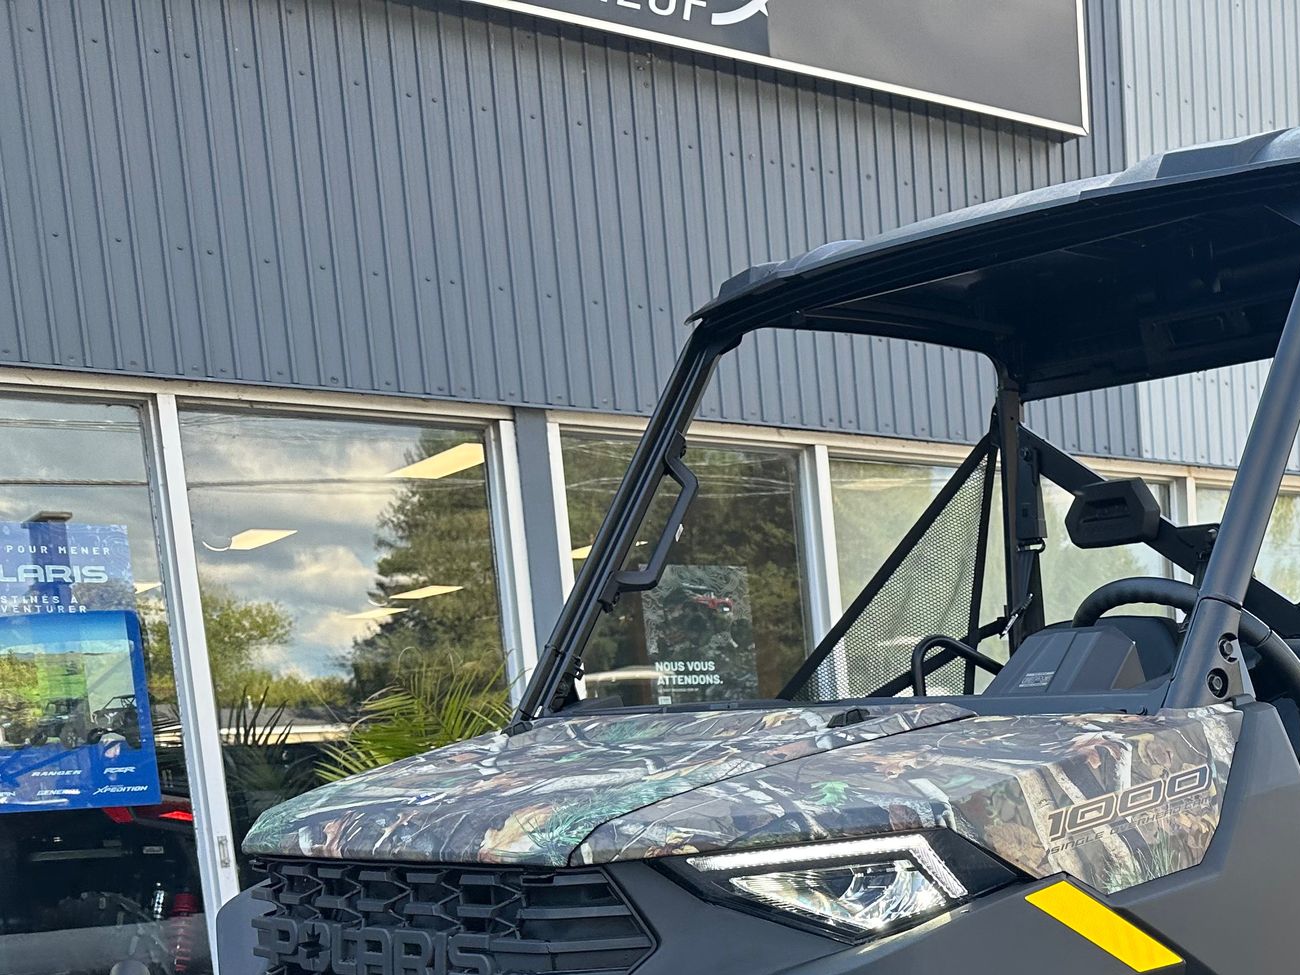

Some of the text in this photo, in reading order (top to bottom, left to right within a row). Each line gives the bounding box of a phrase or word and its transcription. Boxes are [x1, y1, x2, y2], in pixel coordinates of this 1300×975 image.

[6, 545, 110, 555] POUR MENER
[655, 661, 716, 672] NOUS VOUS
[657, 674, 724, 686] ATTENDONS.
[31, 769, 83, 777] RANGER
[1048, 763, 1212, 842] 1000
[1050, 830, 1104, 855] SINGLE
